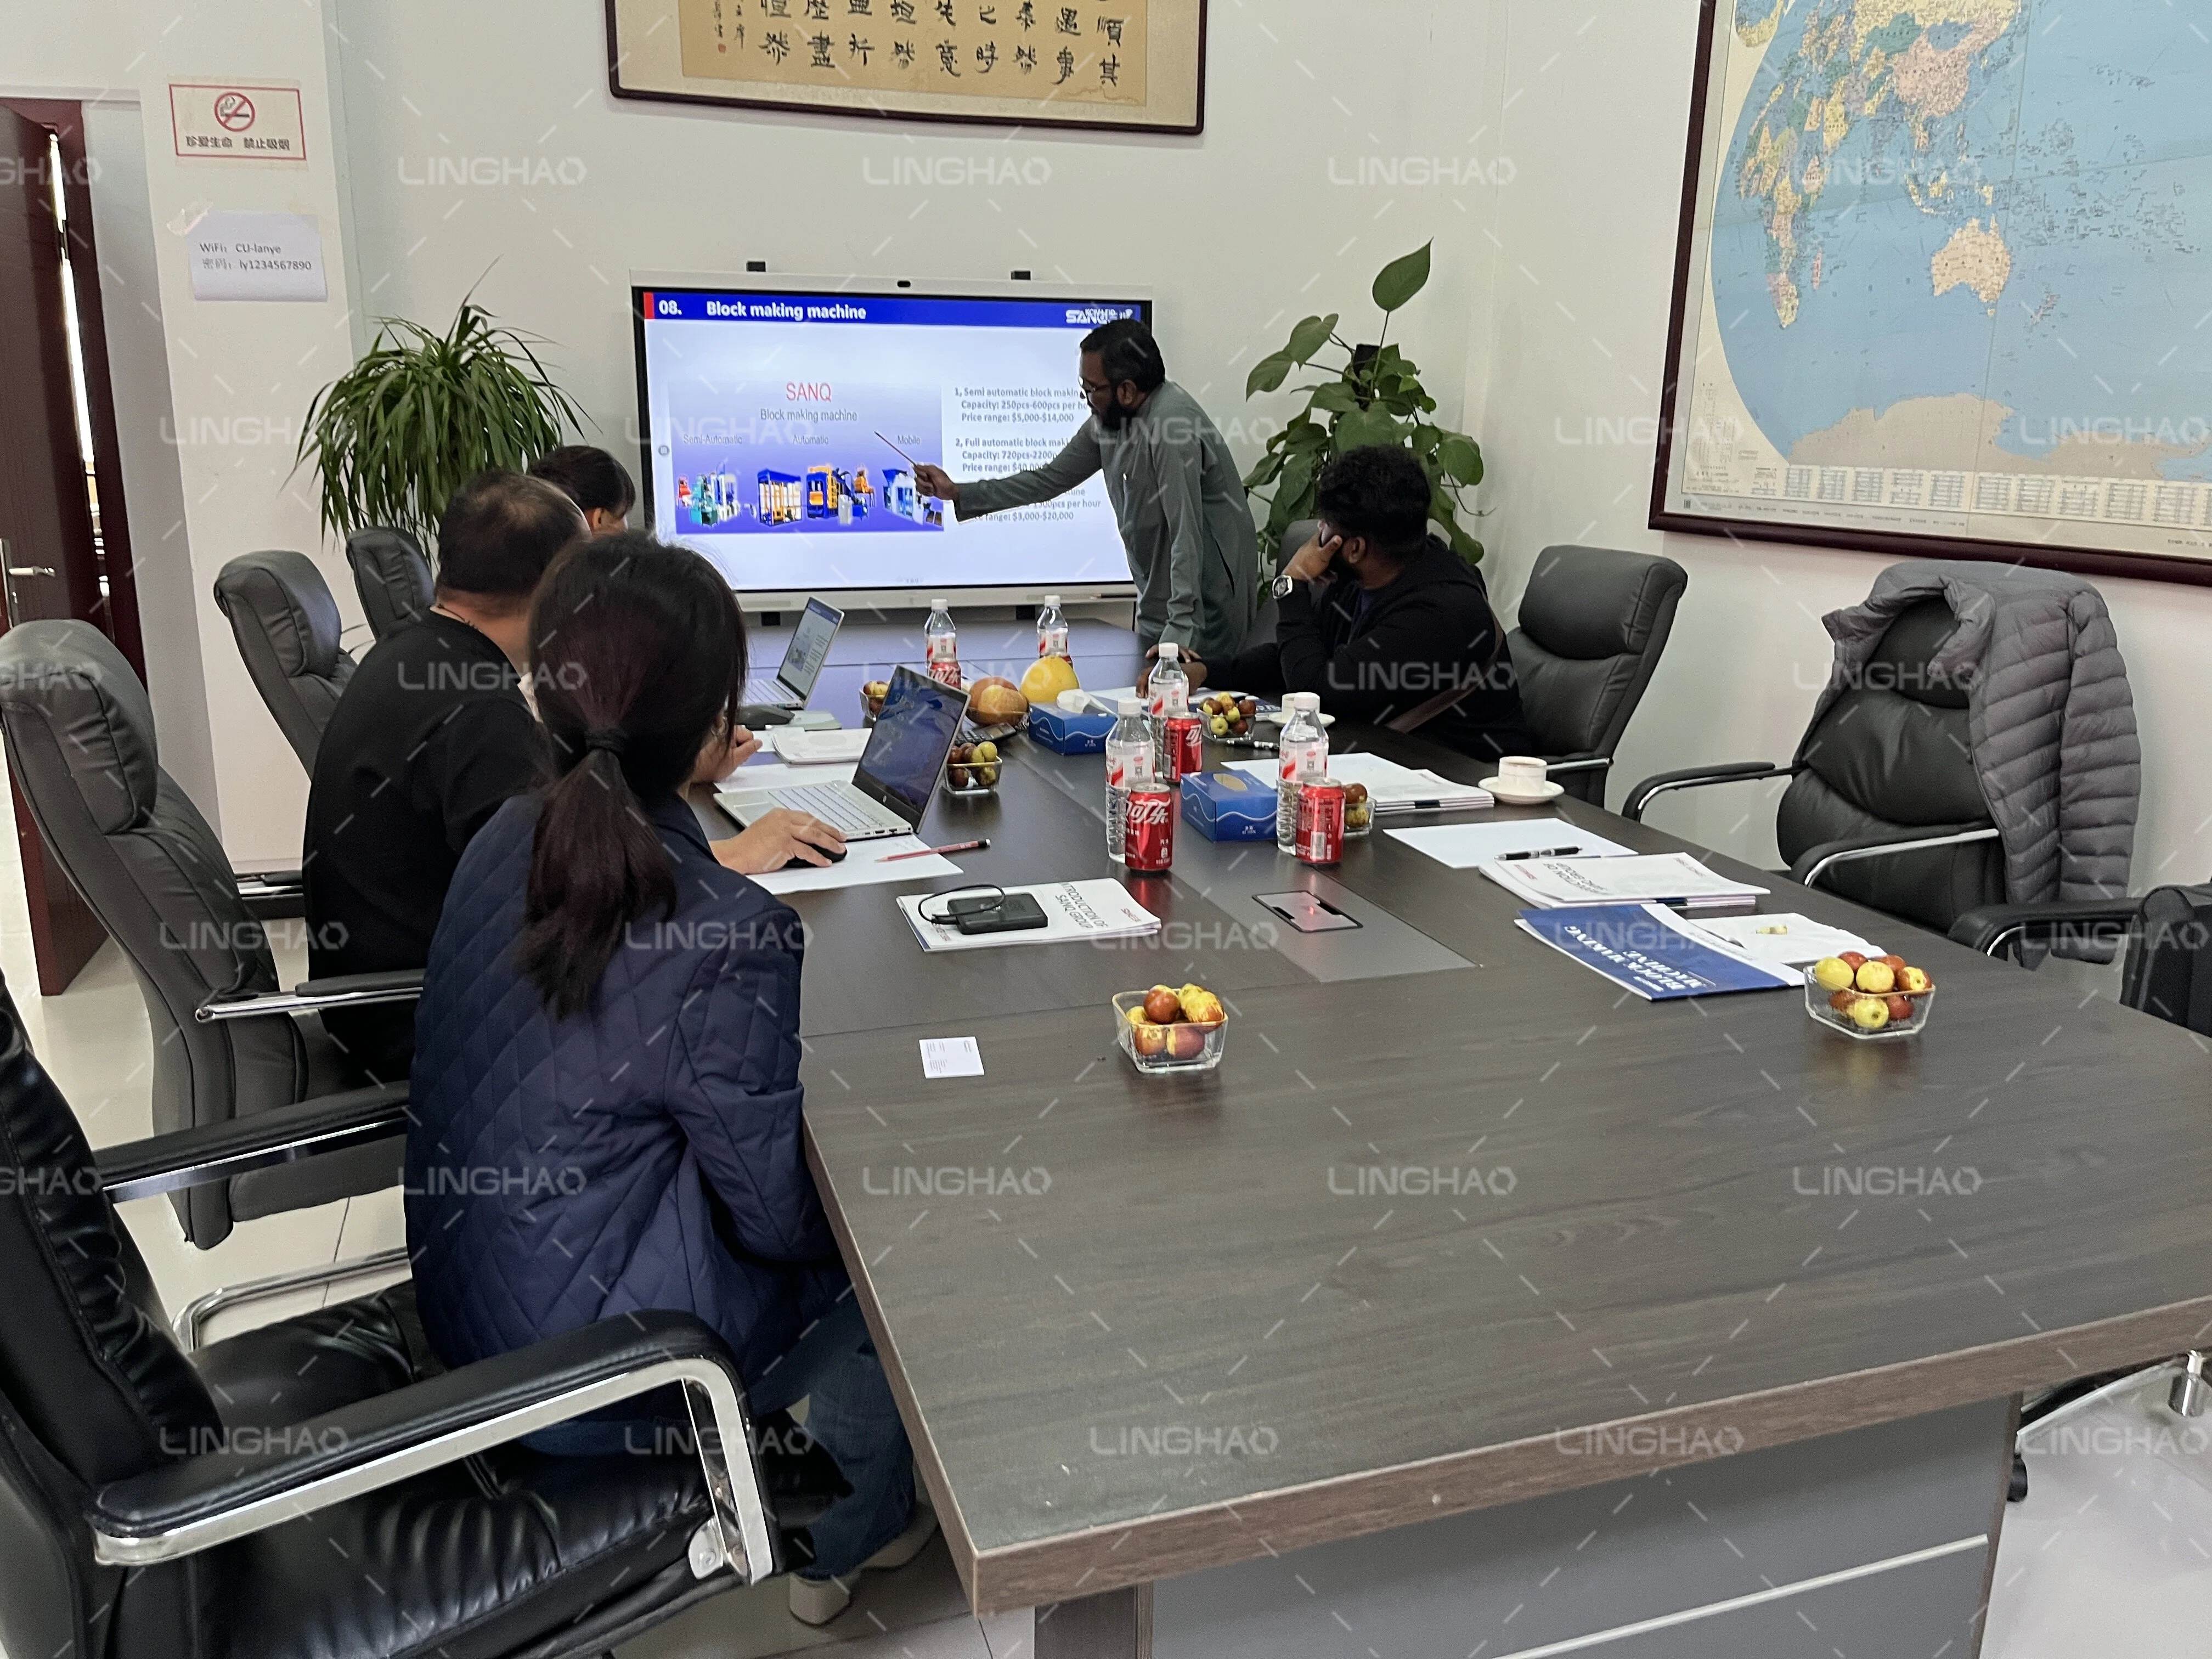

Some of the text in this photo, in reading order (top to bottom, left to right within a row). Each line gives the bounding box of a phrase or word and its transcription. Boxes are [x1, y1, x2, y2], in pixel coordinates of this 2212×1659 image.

[658, 300, 866, 321] 08. Block making machine
[786, 382, 831, 402] SANQ
[964, 387, 984, 397] Semi
[988, 388, 1028, 397] automatic
[1030, 388, 1052, 397] block
[1054, 388, 1079, 397] makin
[961, 400, 999, 410] Capacity:
[1001, 400, 1060, 411] 250pcs-600pcs
[1062, 402, 1075, 411] per
[760, 408, 857, 423] Block making machine
[962, 413, 1074, 423] Price range: $5,000-$14,000
[684, 435, 743, 444] Semi-Automatic
[792, 435, 829, 444] Automatic
[898, 435, 921, 444] Mobile
[965, 438, 980, 447] Full
[982, 438, 1023, 447] automatic
[1025, 438, 1047, 447] block
[962, 451, 1000, 461] Capacity:
[962, 463, 982, 472] Price
[985, 465, 1010, 473] range:
[1067, 501, 1081, 510] per
[1082, 499, 1101, 507] hour
[1013, 511, 1074, 521] $3,000-$20,000
